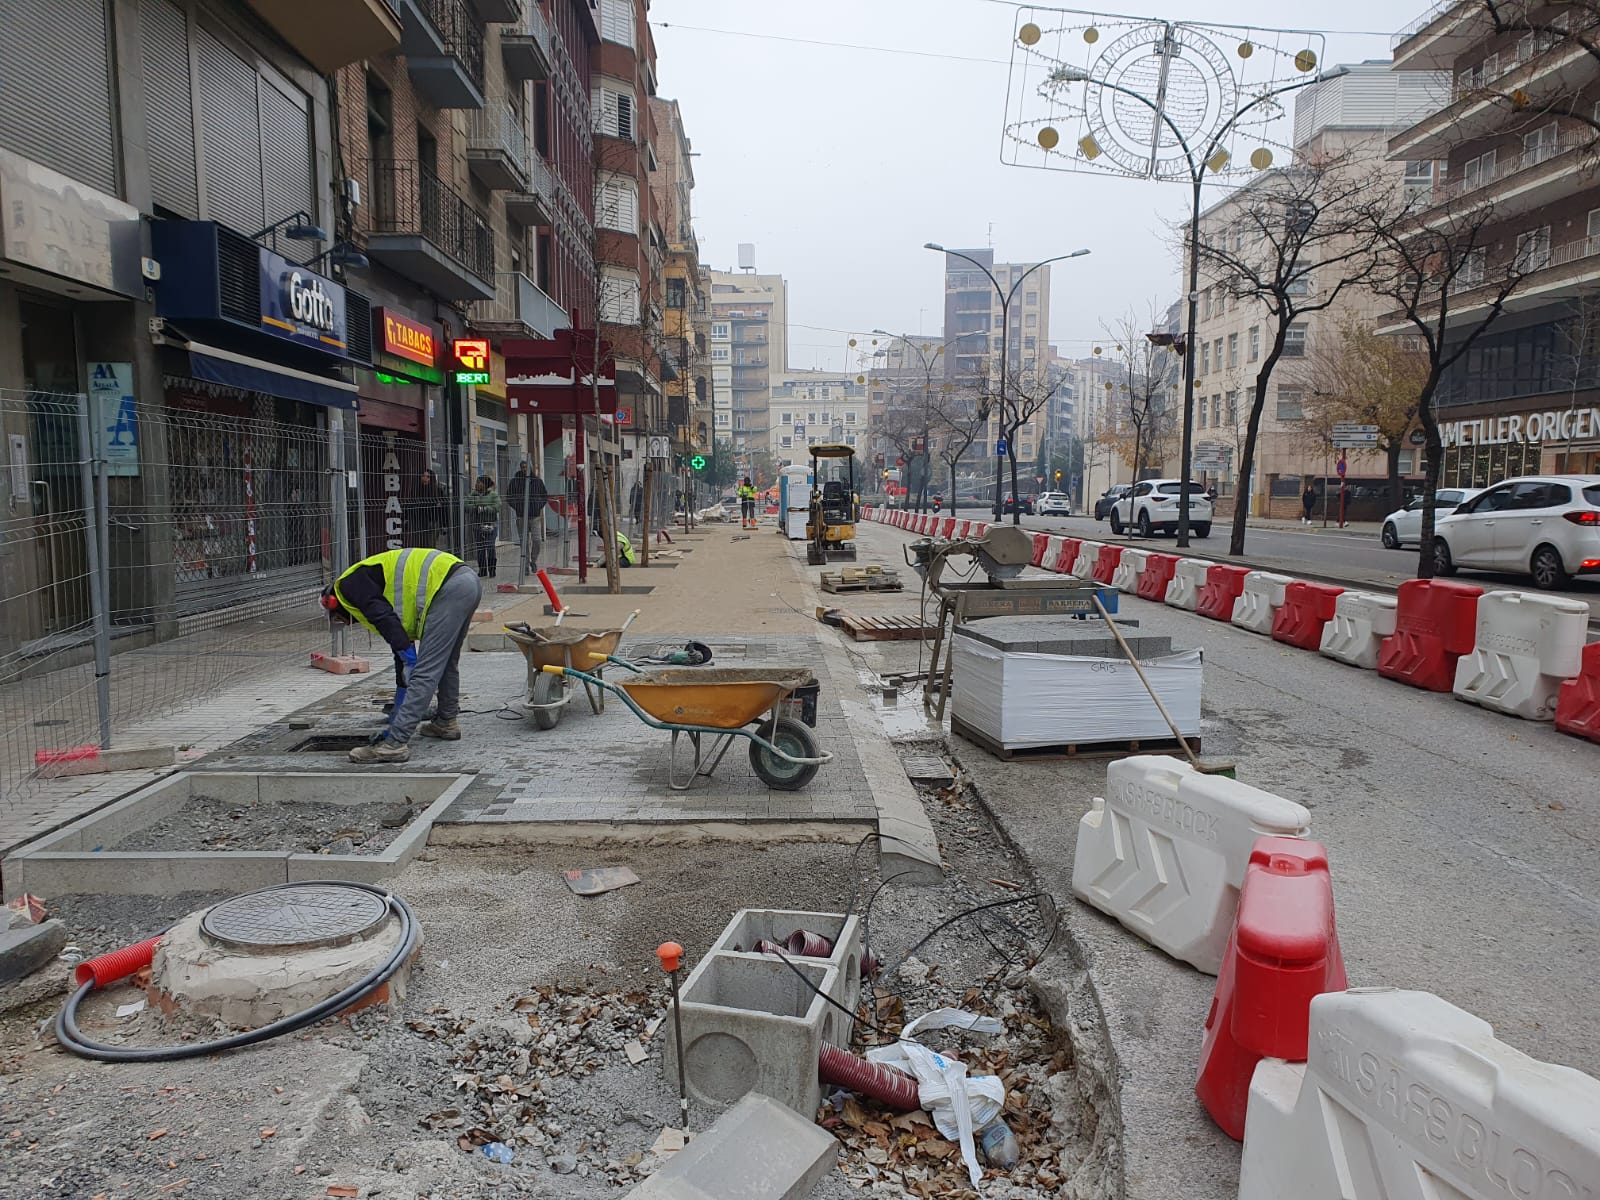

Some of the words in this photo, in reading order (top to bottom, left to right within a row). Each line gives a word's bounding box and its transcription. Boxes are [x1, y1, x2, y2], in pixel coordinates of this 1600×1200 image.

[290, 271, 334, 331] Gotta
[395, 321, 433, 354] TABACS
[1526, 408, 1600, 442] ORIGEN
[381, 430, 403, 550] TABACS
[1354, 1050, 1598, 1200] SAFEBLOC
